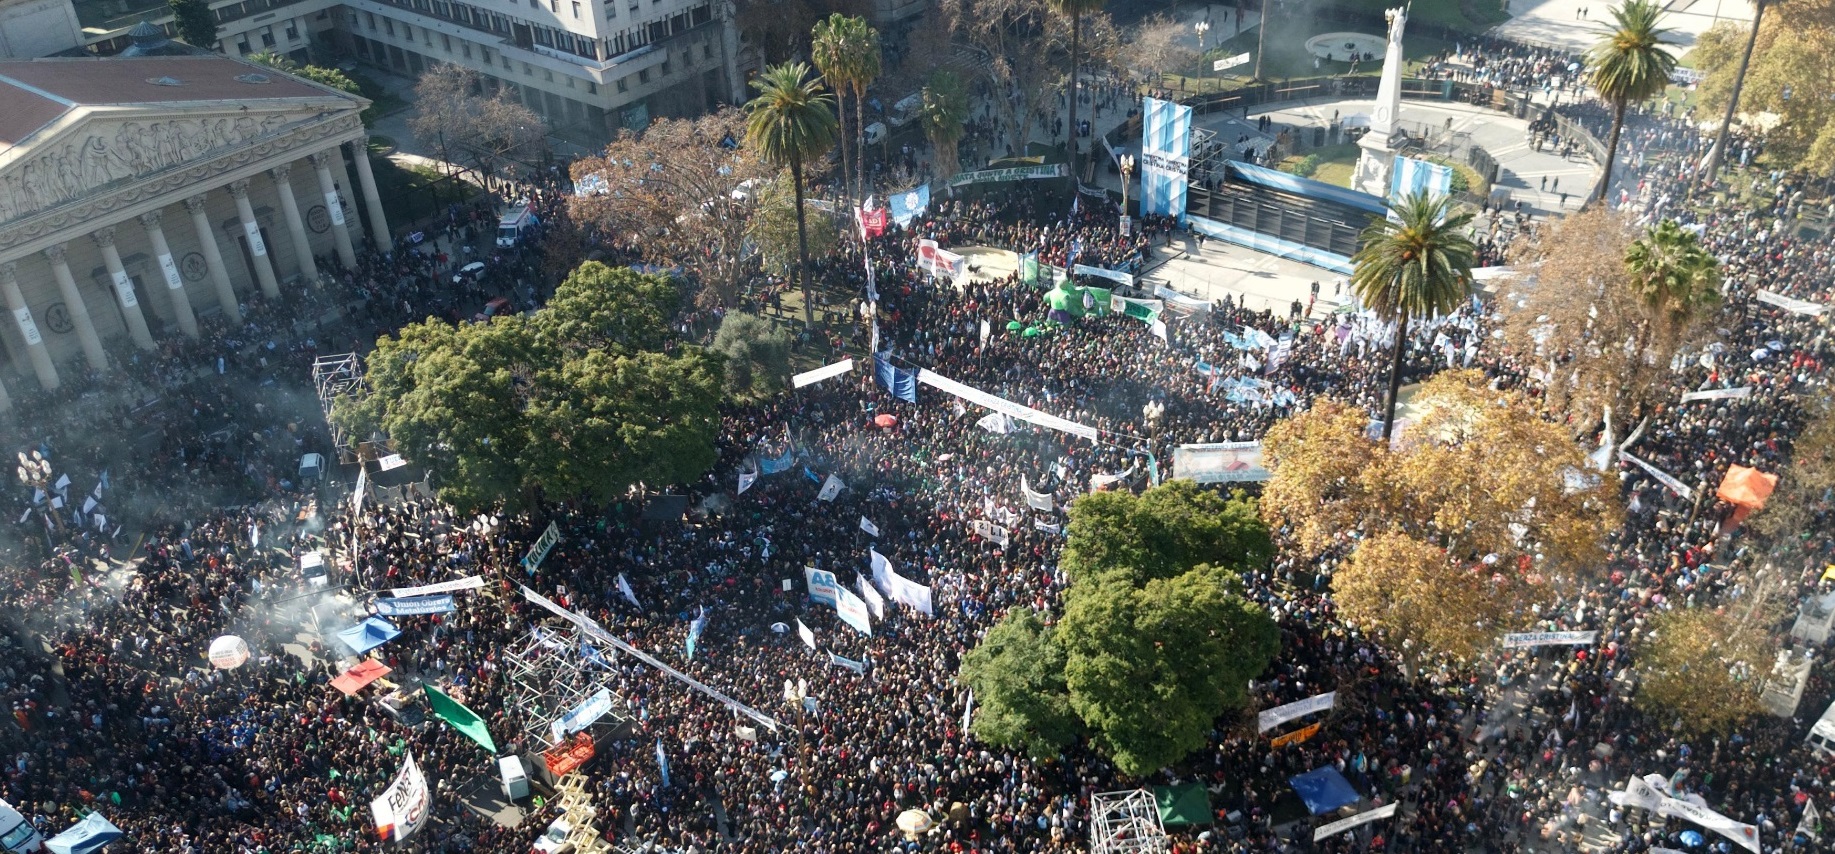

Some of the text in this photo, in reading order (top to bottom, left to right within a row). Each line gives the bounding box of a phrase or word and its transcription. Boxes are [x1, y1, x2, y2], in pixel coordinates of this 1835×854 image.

[1013, 164, 1057, 177] CRISTINA
[1508, 633, 1573, 642] FUERZA CRISTINA
